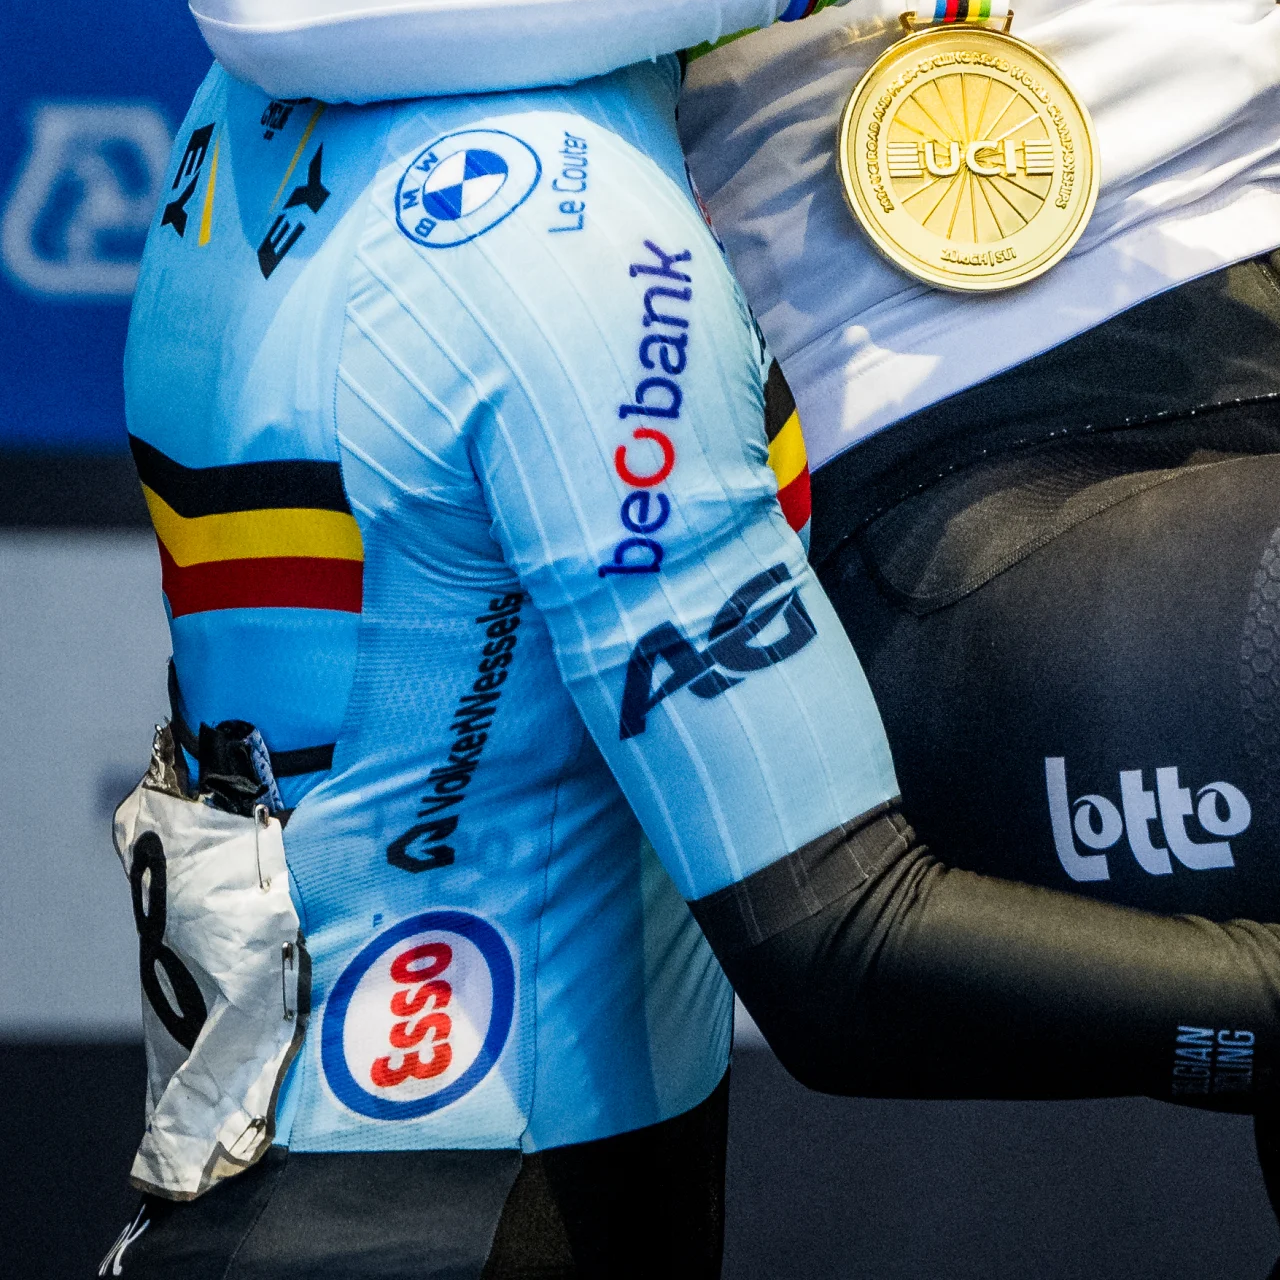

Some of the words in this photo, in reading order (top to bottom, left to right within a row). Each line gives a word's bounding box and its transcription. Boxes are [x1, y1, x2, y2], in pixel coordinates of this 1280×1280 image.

[872, 93, 894, 123] AND
[1010, 64, 1050, 105] WORLD
[160, 122, 216, 239] EY
[555, 130, 591, 196] Couter
[866, 121, 881, 161] ROAD
[924, 139, 1017, 178] UCI
[1046, 101, 1076, 210] CHAMPIONSHIPS
[257, 142, 331, 280] EY
[548, 200, 585, 234] Le
[600, 238, 694, 578] beobank
[422, 591, 525, 820] VolkerWessels
[618, 562, 818, 741] AG
[1044, 756, 1252, 882] lotto
